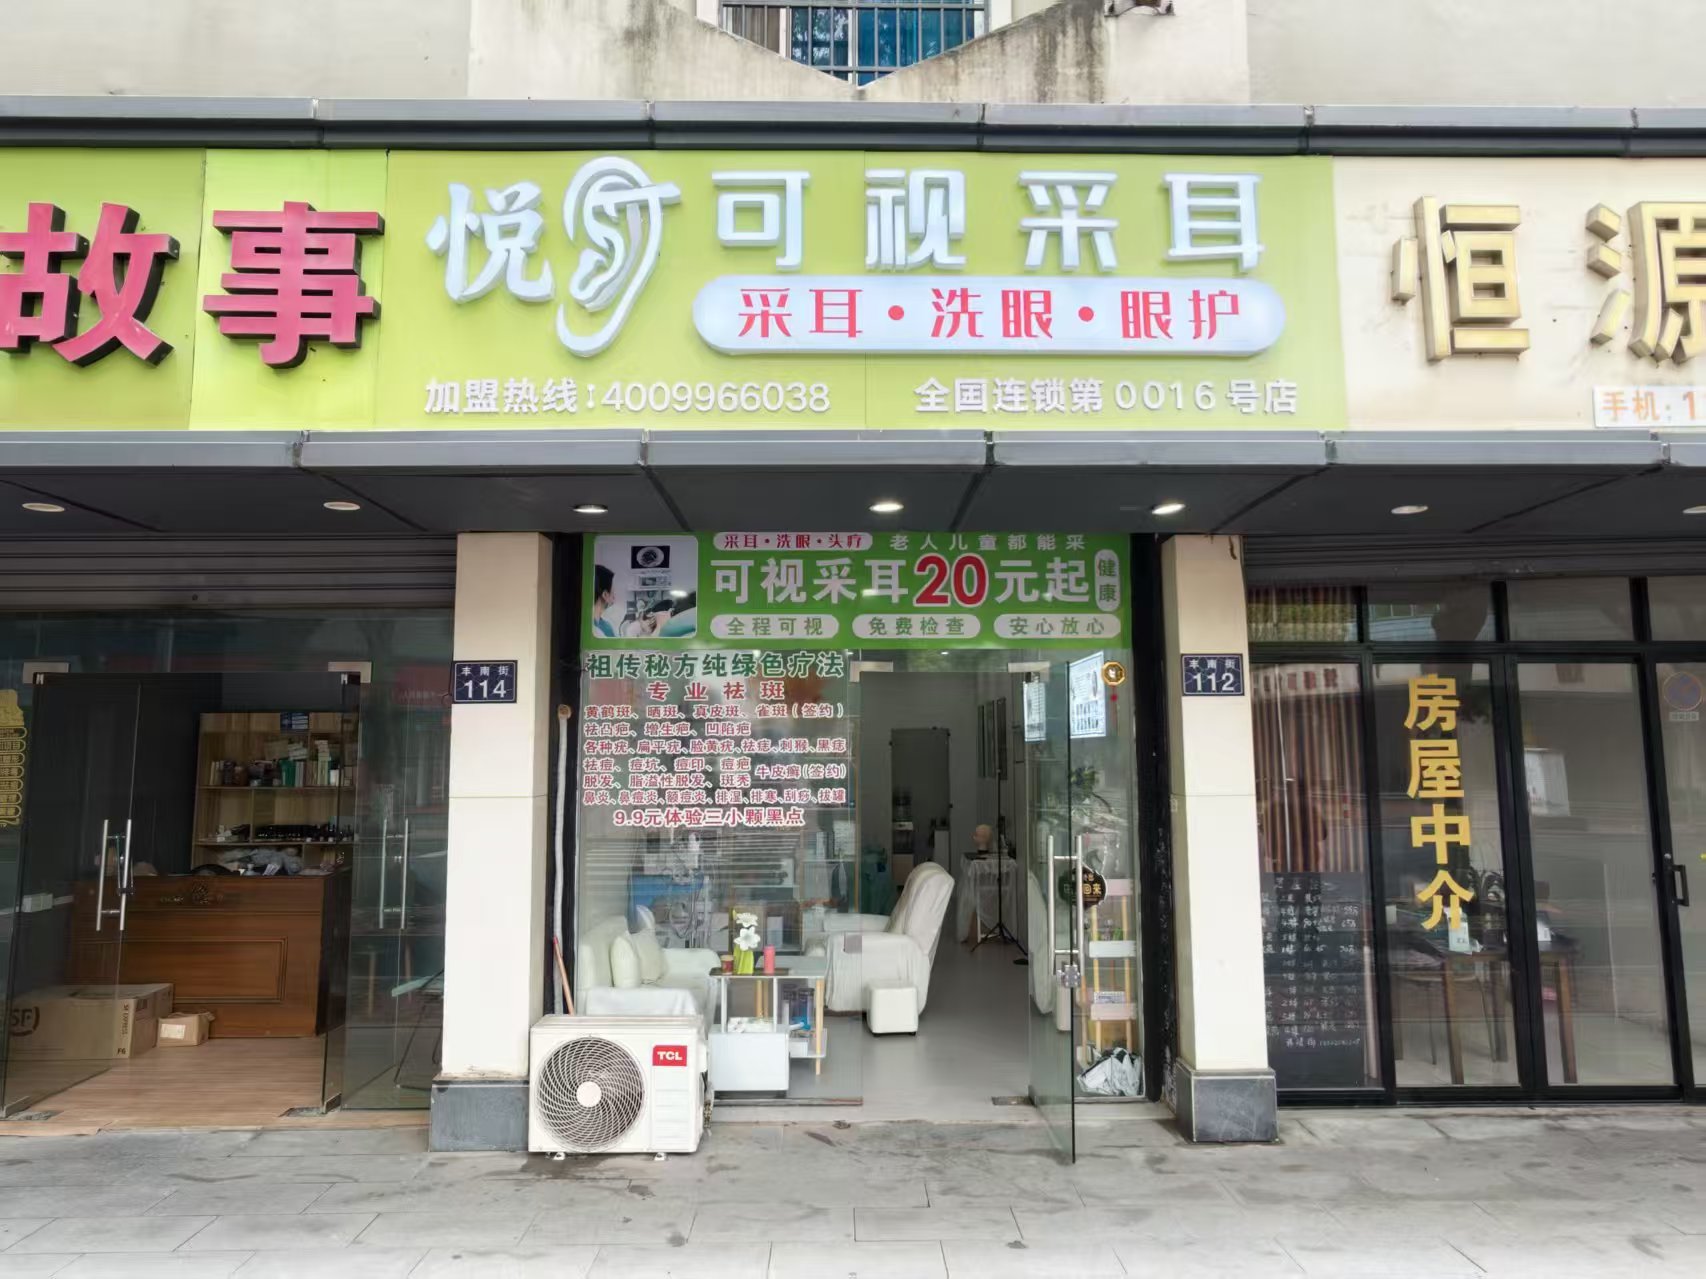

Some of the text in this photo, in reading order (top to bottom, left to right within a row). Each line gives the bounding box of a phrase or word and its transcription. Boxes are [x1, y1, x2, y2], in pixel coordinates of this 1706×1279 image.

[425, 168, 1265, 304] 悦 可视采耳
[0, 200, 386, 369] 故事
[1390, 195, 1706, 365] 恒源
[424, 377, 832, 415] 加盟热线:4009966038
[914, 376, 1299, 415] 全国连锁第0016号店
[889, 533, 1086, 551] 老人儿童都能采
[710, 552, 1090, 608] 可视采耳20元起
[1098, 557, 1118, 603] 健康
[727, 617, 824, 637] 全程可视
[868, 616, 966, 637] 免费检查
[1008, 616, 1106, 637] 安心放心
[586, 652, 846, 679] 祖传秘方纯绿色疗法
[463, 679, 508, 699] 114
[646, 681, 785, 701] 专业祛斑
[1192, 672, 1235, 692] 112
[1403, 673, 1475, 931] 房屋中介
[613, 805, 806, 828] 9.9元体验三小颗黑点
[656, 1050, 683, 1062] TCL
